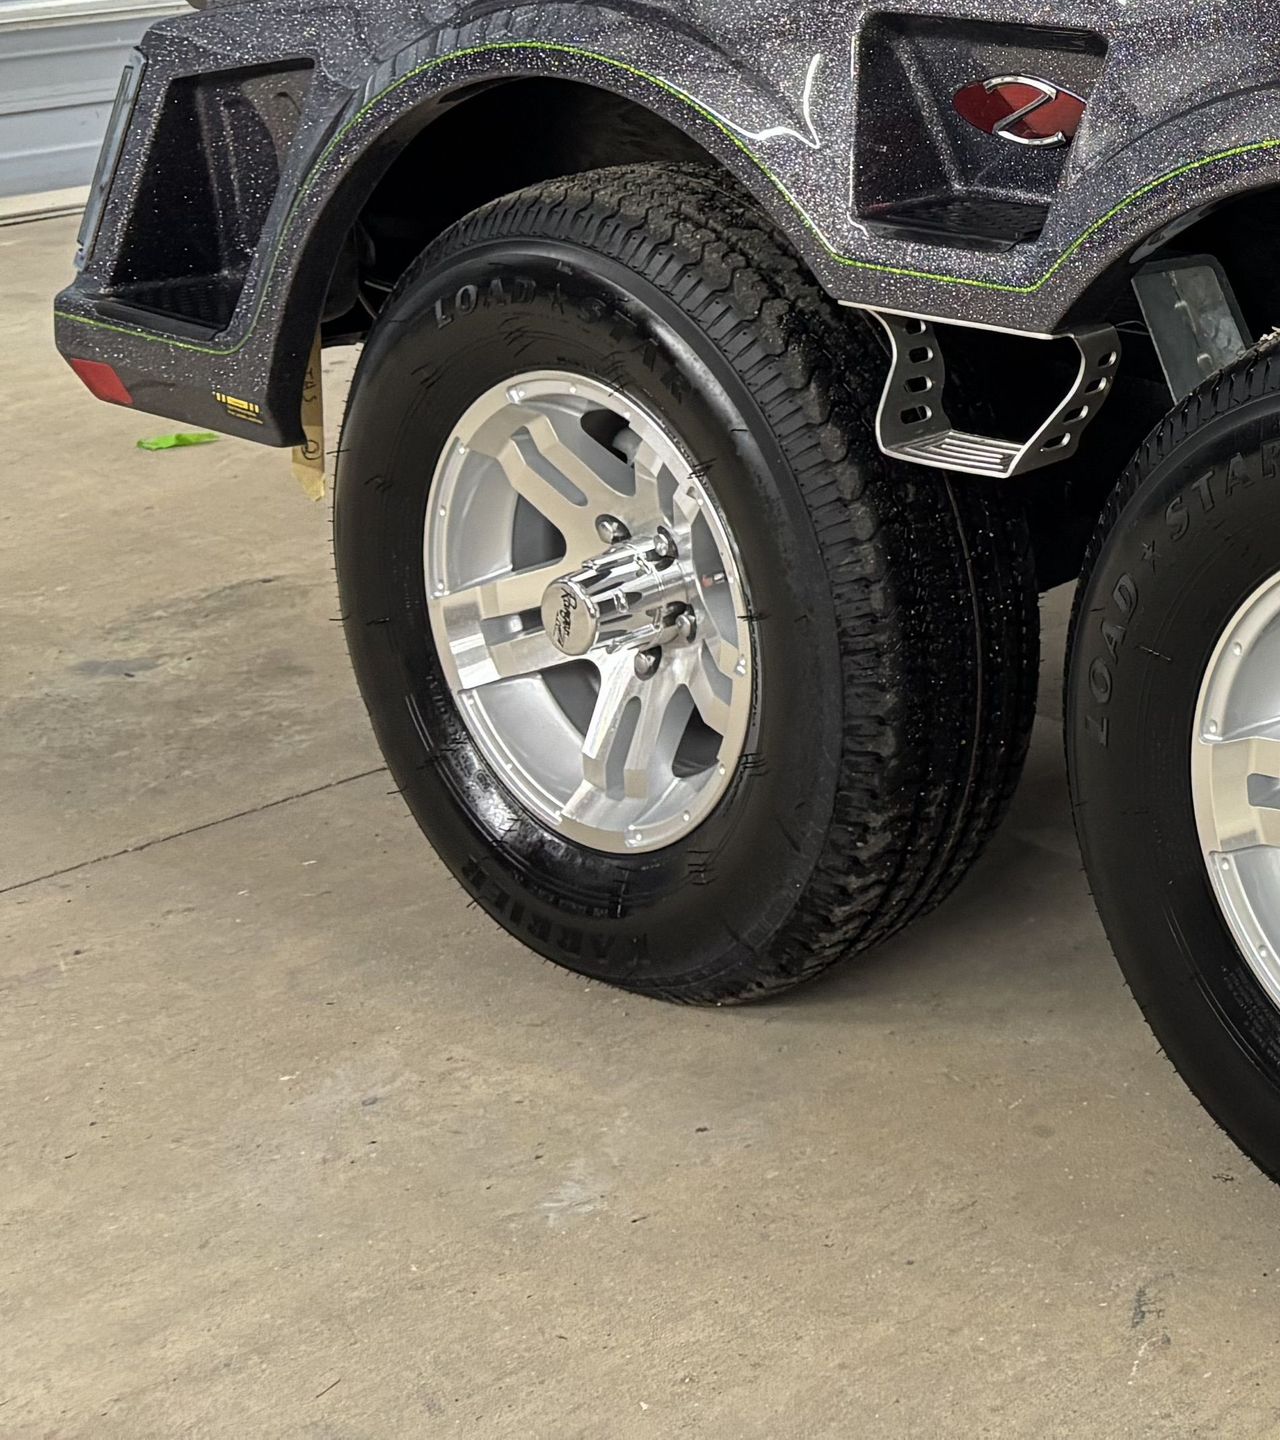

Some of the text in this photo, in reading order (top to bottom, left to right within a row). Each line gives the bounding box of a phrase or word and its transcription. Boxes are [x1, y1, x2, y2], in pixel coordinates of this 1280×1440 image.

[433, 277, 696, 405] LOAD STAR
[1083, 571, 1141, 749] LOAD
